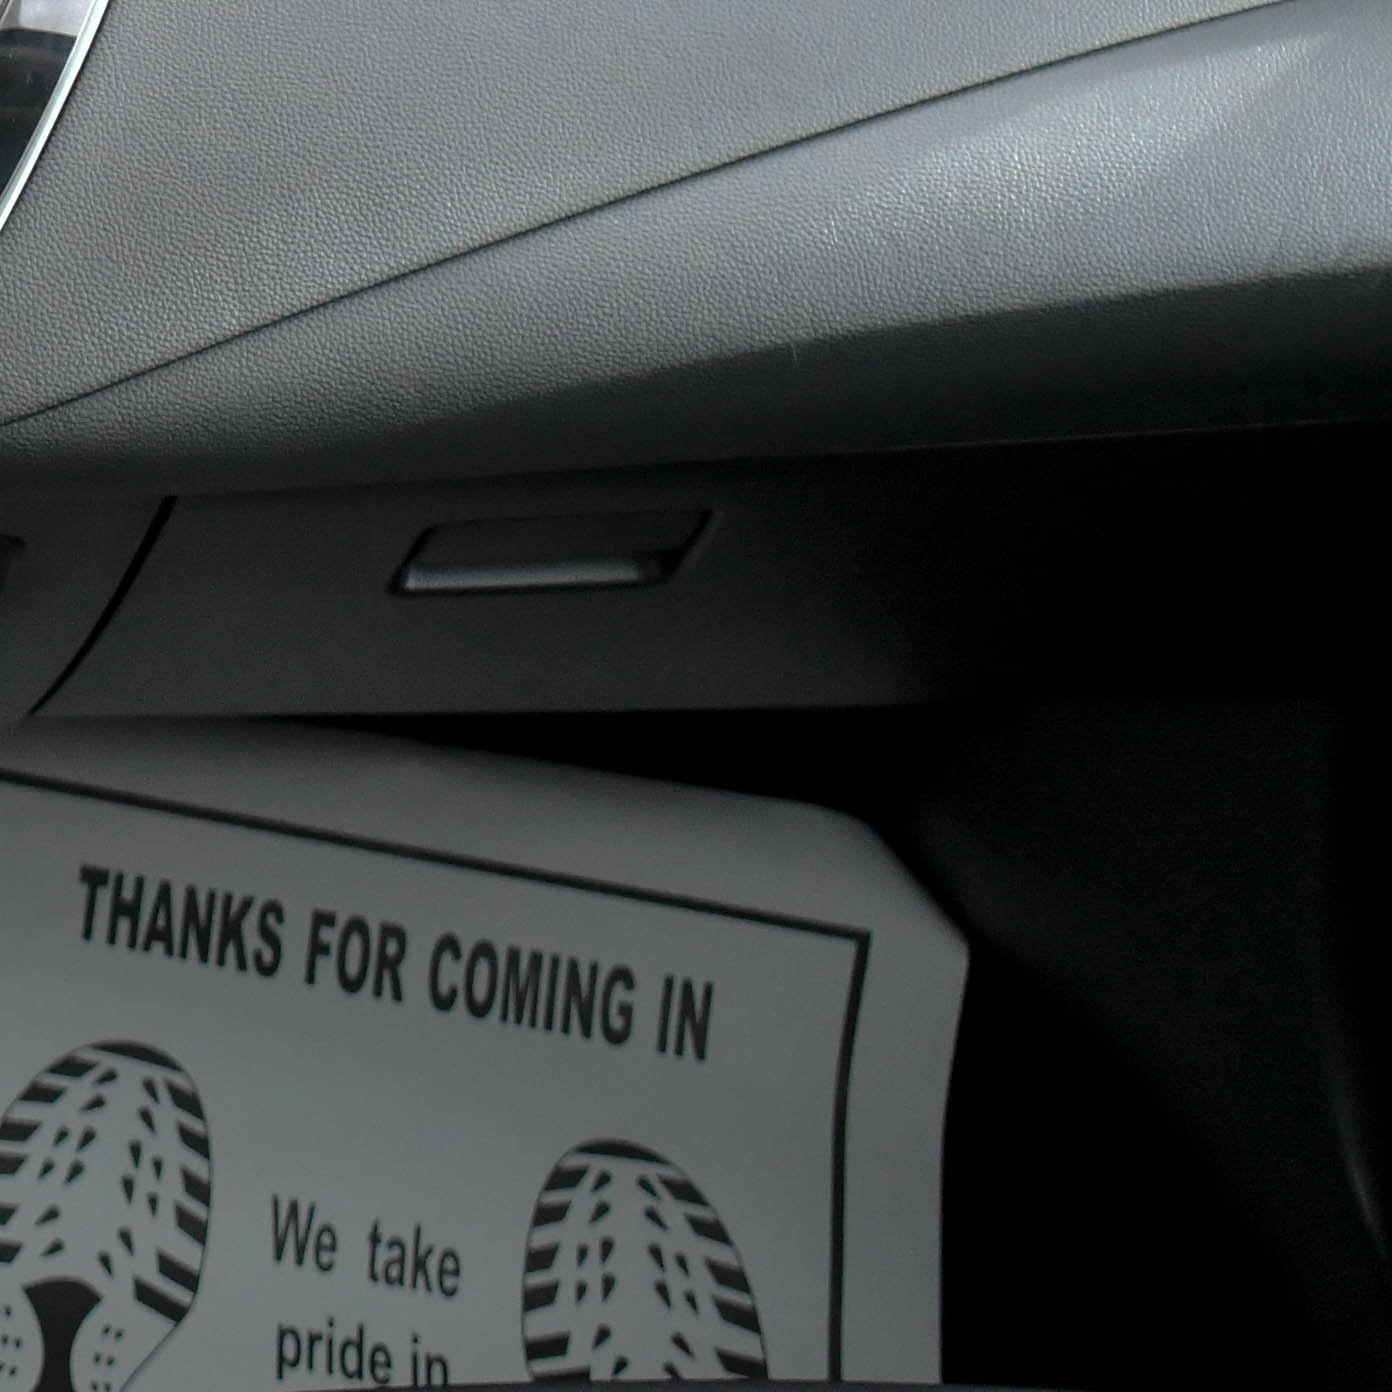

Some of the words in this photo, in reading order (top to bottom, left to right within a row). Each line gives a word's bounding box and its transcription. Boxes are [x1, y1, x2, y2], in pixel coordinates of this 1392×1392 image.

[78, 864, 285, 978] THANKS
[304, 908, 406, 1002] FOR
[428, 932, 635, 1047] COMING
[655, 973, 715, 1063] IN
[270, 1193, 339, 1274] We
[367, 1222, 463, 1299] take
[274, 1319, 393, 1390] pride
[410, 1337, 451, 1388] in
